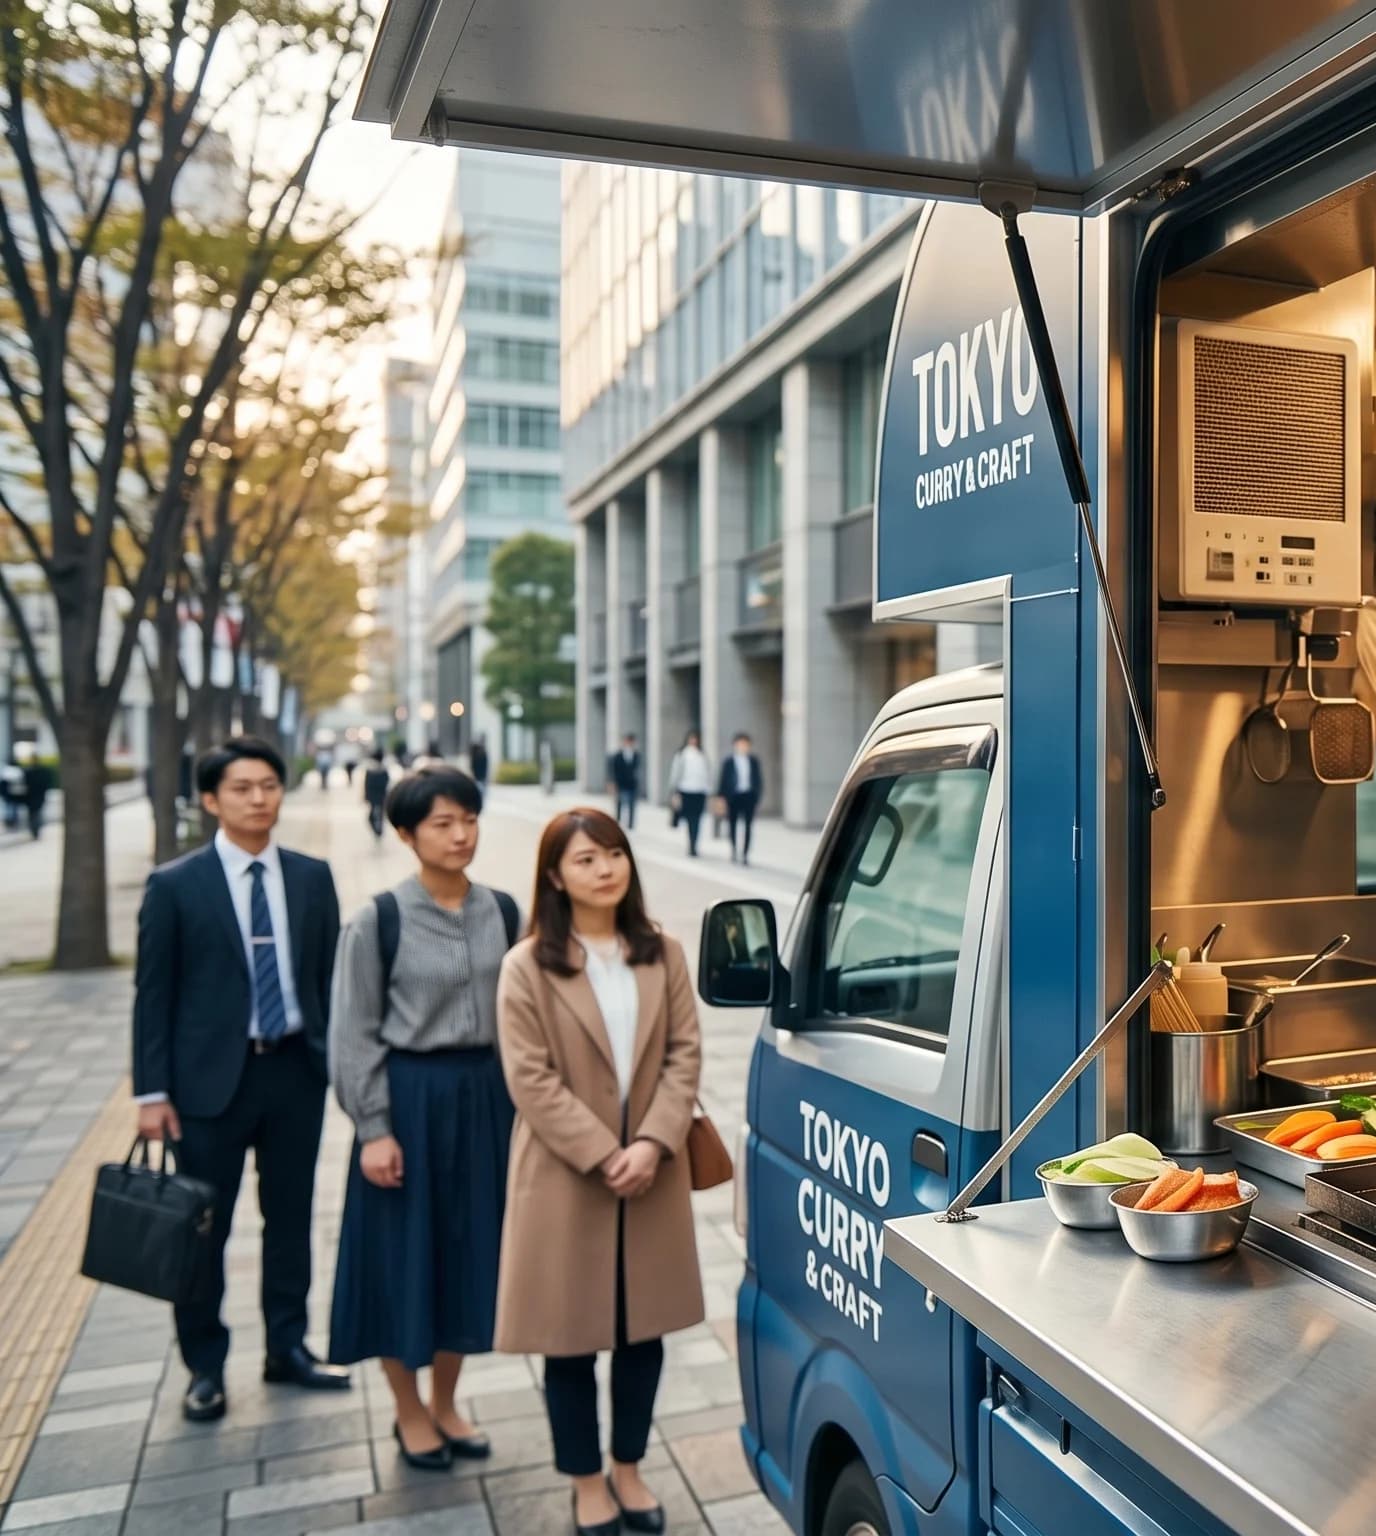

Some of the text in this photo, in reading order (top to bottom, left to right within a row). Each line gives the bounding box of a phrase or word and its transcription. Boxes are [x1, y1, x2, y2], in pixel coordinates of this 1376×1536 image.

[912, 304, 1039, 456] TOKYO
[916, 459, 964, 509] CURRY
[977, 433, 1034, 490] CRAFT
[800, 1100, 890, 1208] TOKYO
[798, 1178, 884, 1289] CURRY
[805, 1250, 883, 1342] & CRAFT
